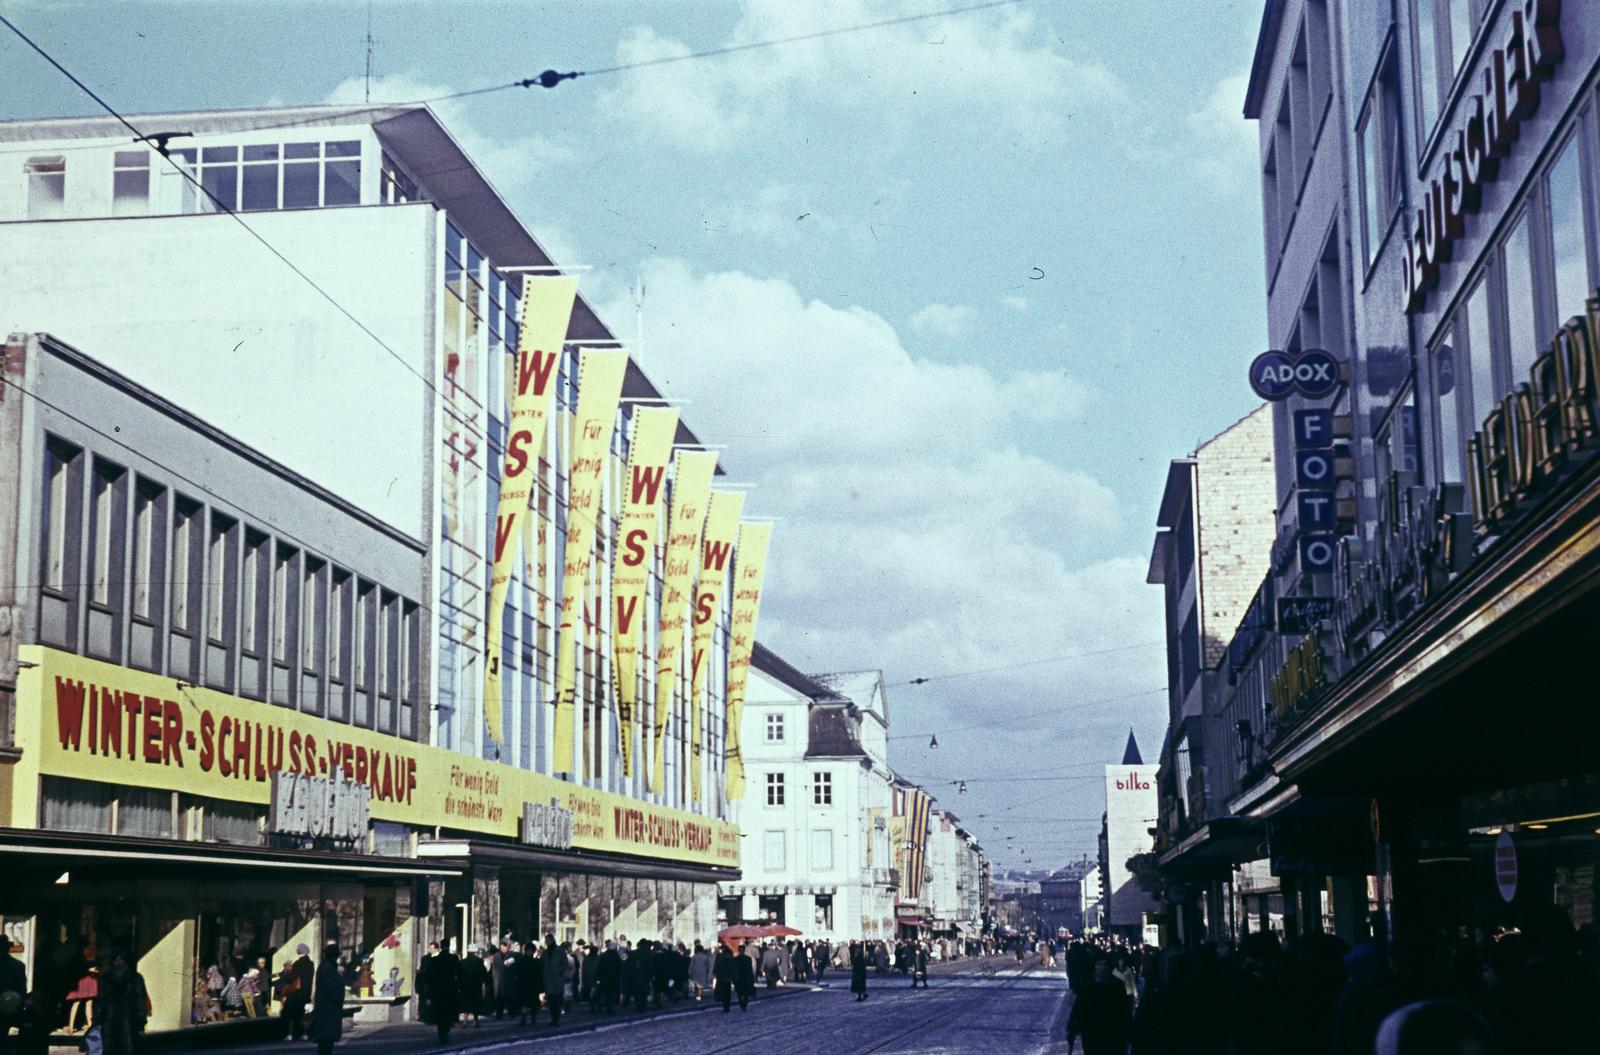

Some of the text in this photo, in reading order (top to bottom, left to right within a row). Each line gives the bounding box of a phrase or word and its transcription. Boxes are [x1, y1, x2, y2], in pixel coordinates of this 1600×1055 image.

[518, 350, 557, 397] W
[1260, 362, 1331, 384] ADOX
[504, 430, 533, 479] S
[632, 465, 664, 505] W
[1304, 415, 1331, 566] FOTO
[494, 513, 516, 564] V
[622, 529, 648, 567] S
[704, 541, 730, 571] W
[617, 596, 638, 635] V
[695, 593, 715, 625] S
[464, 771, 483, 796] wenig
[485, 771, 499, 796] Geld
[1114, 772, 1150, 790] bilka
